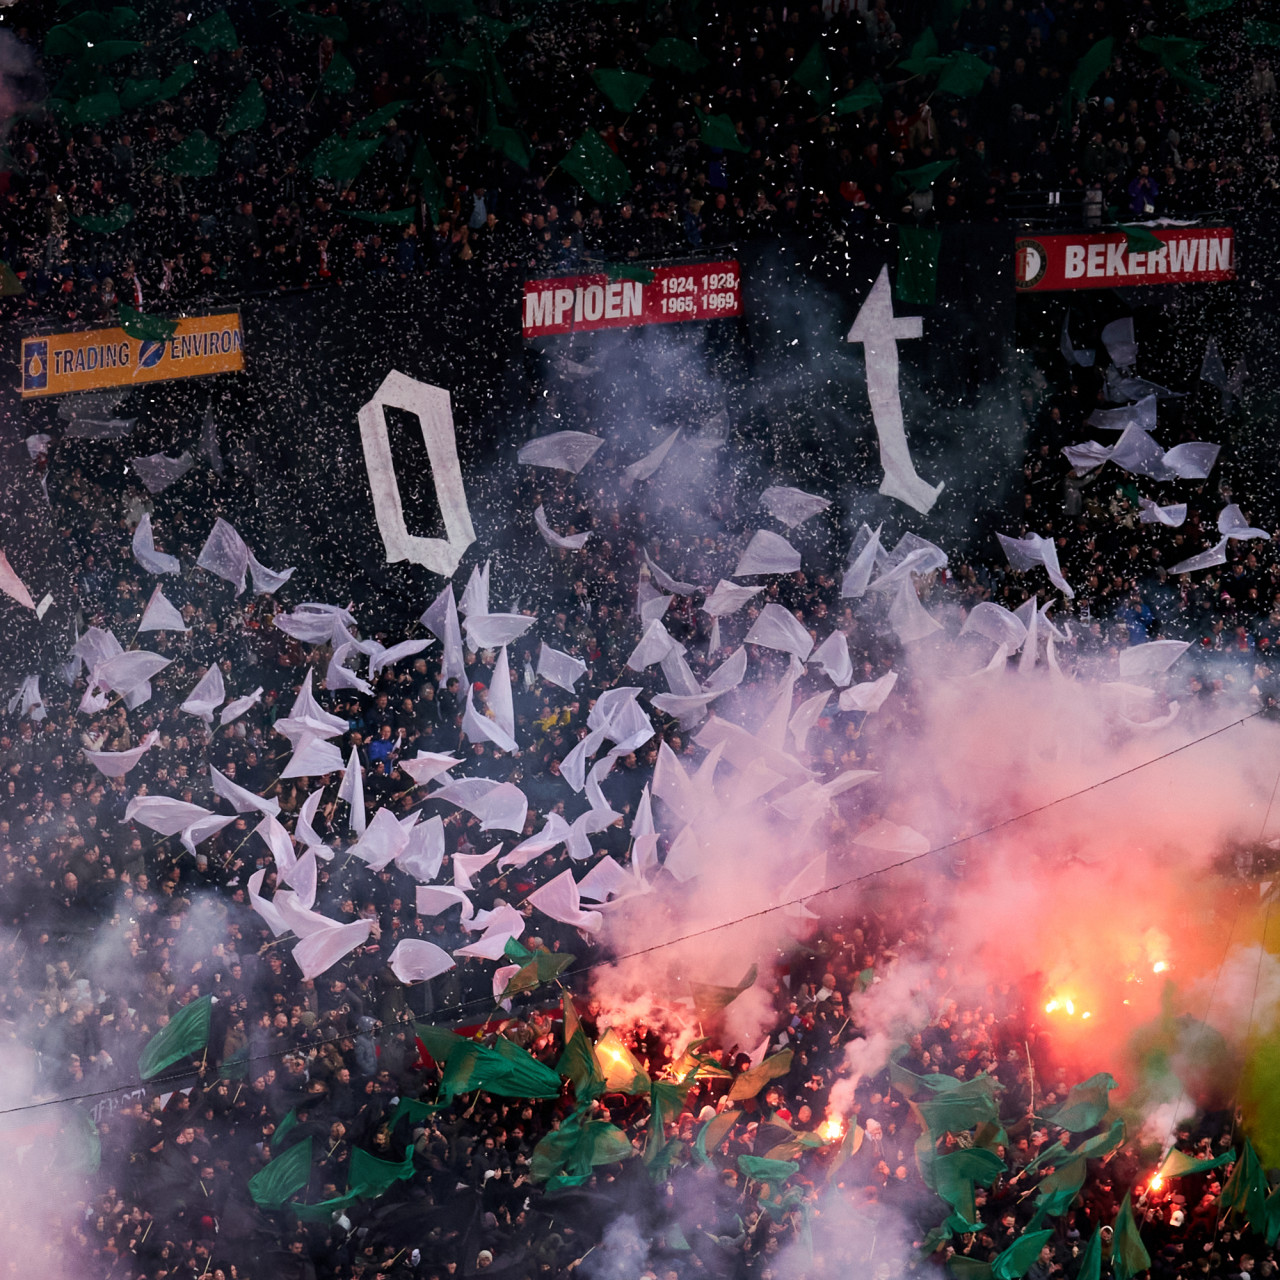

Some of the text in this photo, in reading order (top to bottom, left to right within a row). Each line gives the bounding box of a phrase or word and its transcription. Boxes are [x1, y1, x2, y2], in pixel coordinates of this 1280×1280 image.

[522, 282, 643, 329] MPIOEN
[661, 276, 698, 295] 1924,
[661, 292, 738, 315] 1965, 1969,
[54, 328, 243, 376] TRADING ENVIRON
